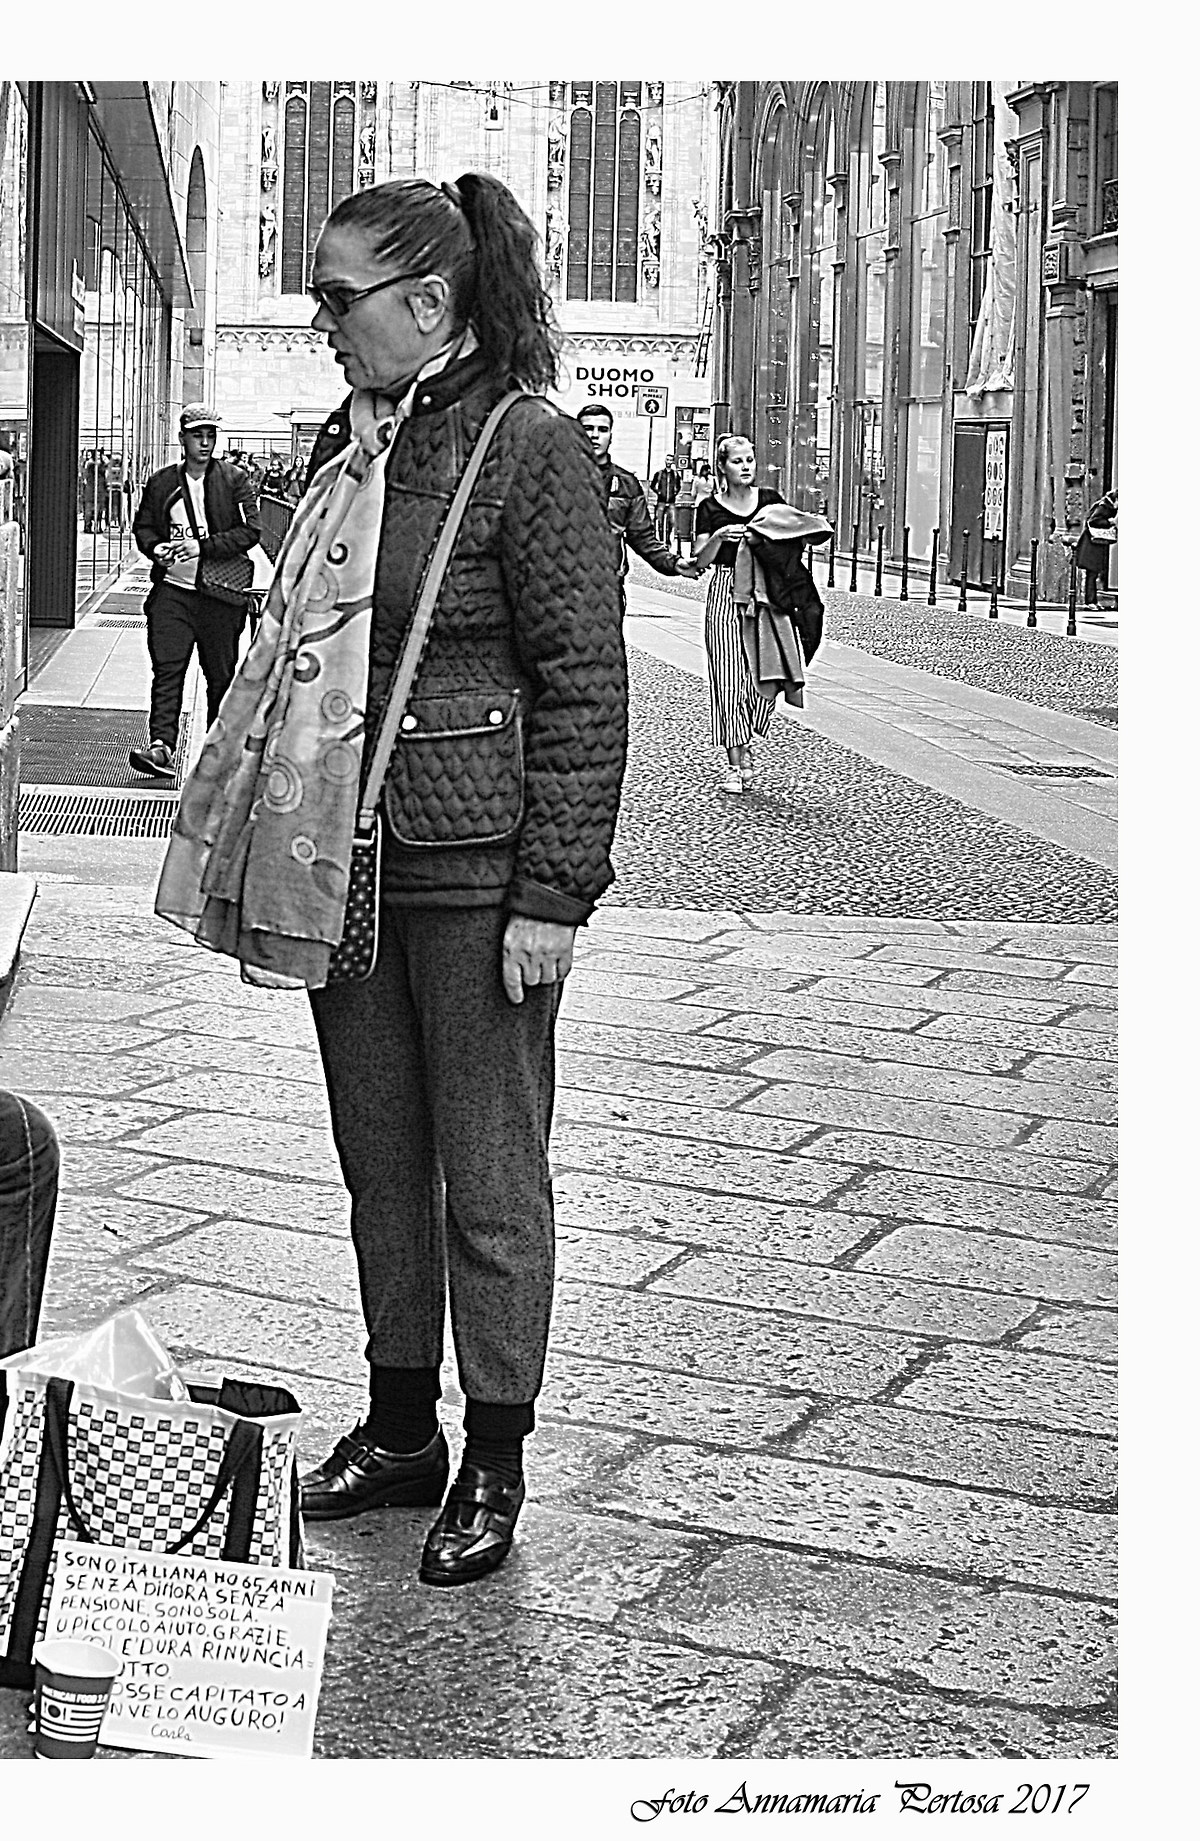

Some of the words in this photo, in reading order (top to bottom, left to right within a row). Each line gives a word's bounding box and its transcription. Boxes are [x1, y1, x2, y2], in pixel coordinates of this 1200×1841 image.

[576, 367, 654, 382] DUOMO
[64, 1551, 117, 1574] SONO
[214, 1572, 238, 1586] HO
[242, 1576, 265, 1596] 65
[65, 1574, 138, 1593] SENZA
[215, 1588, 284, 1612] SENZA
[154, 1602, 203, 1618] SONO
[72, 1614, 150, 1634] PICCOLO
[170, 1685, 288, 1707] CAPITATO
[292, 1693, 306, 1711] A
[156, 1706, 179, 1721] LO
[184, 1704, 285, 1733] AUGURO!
